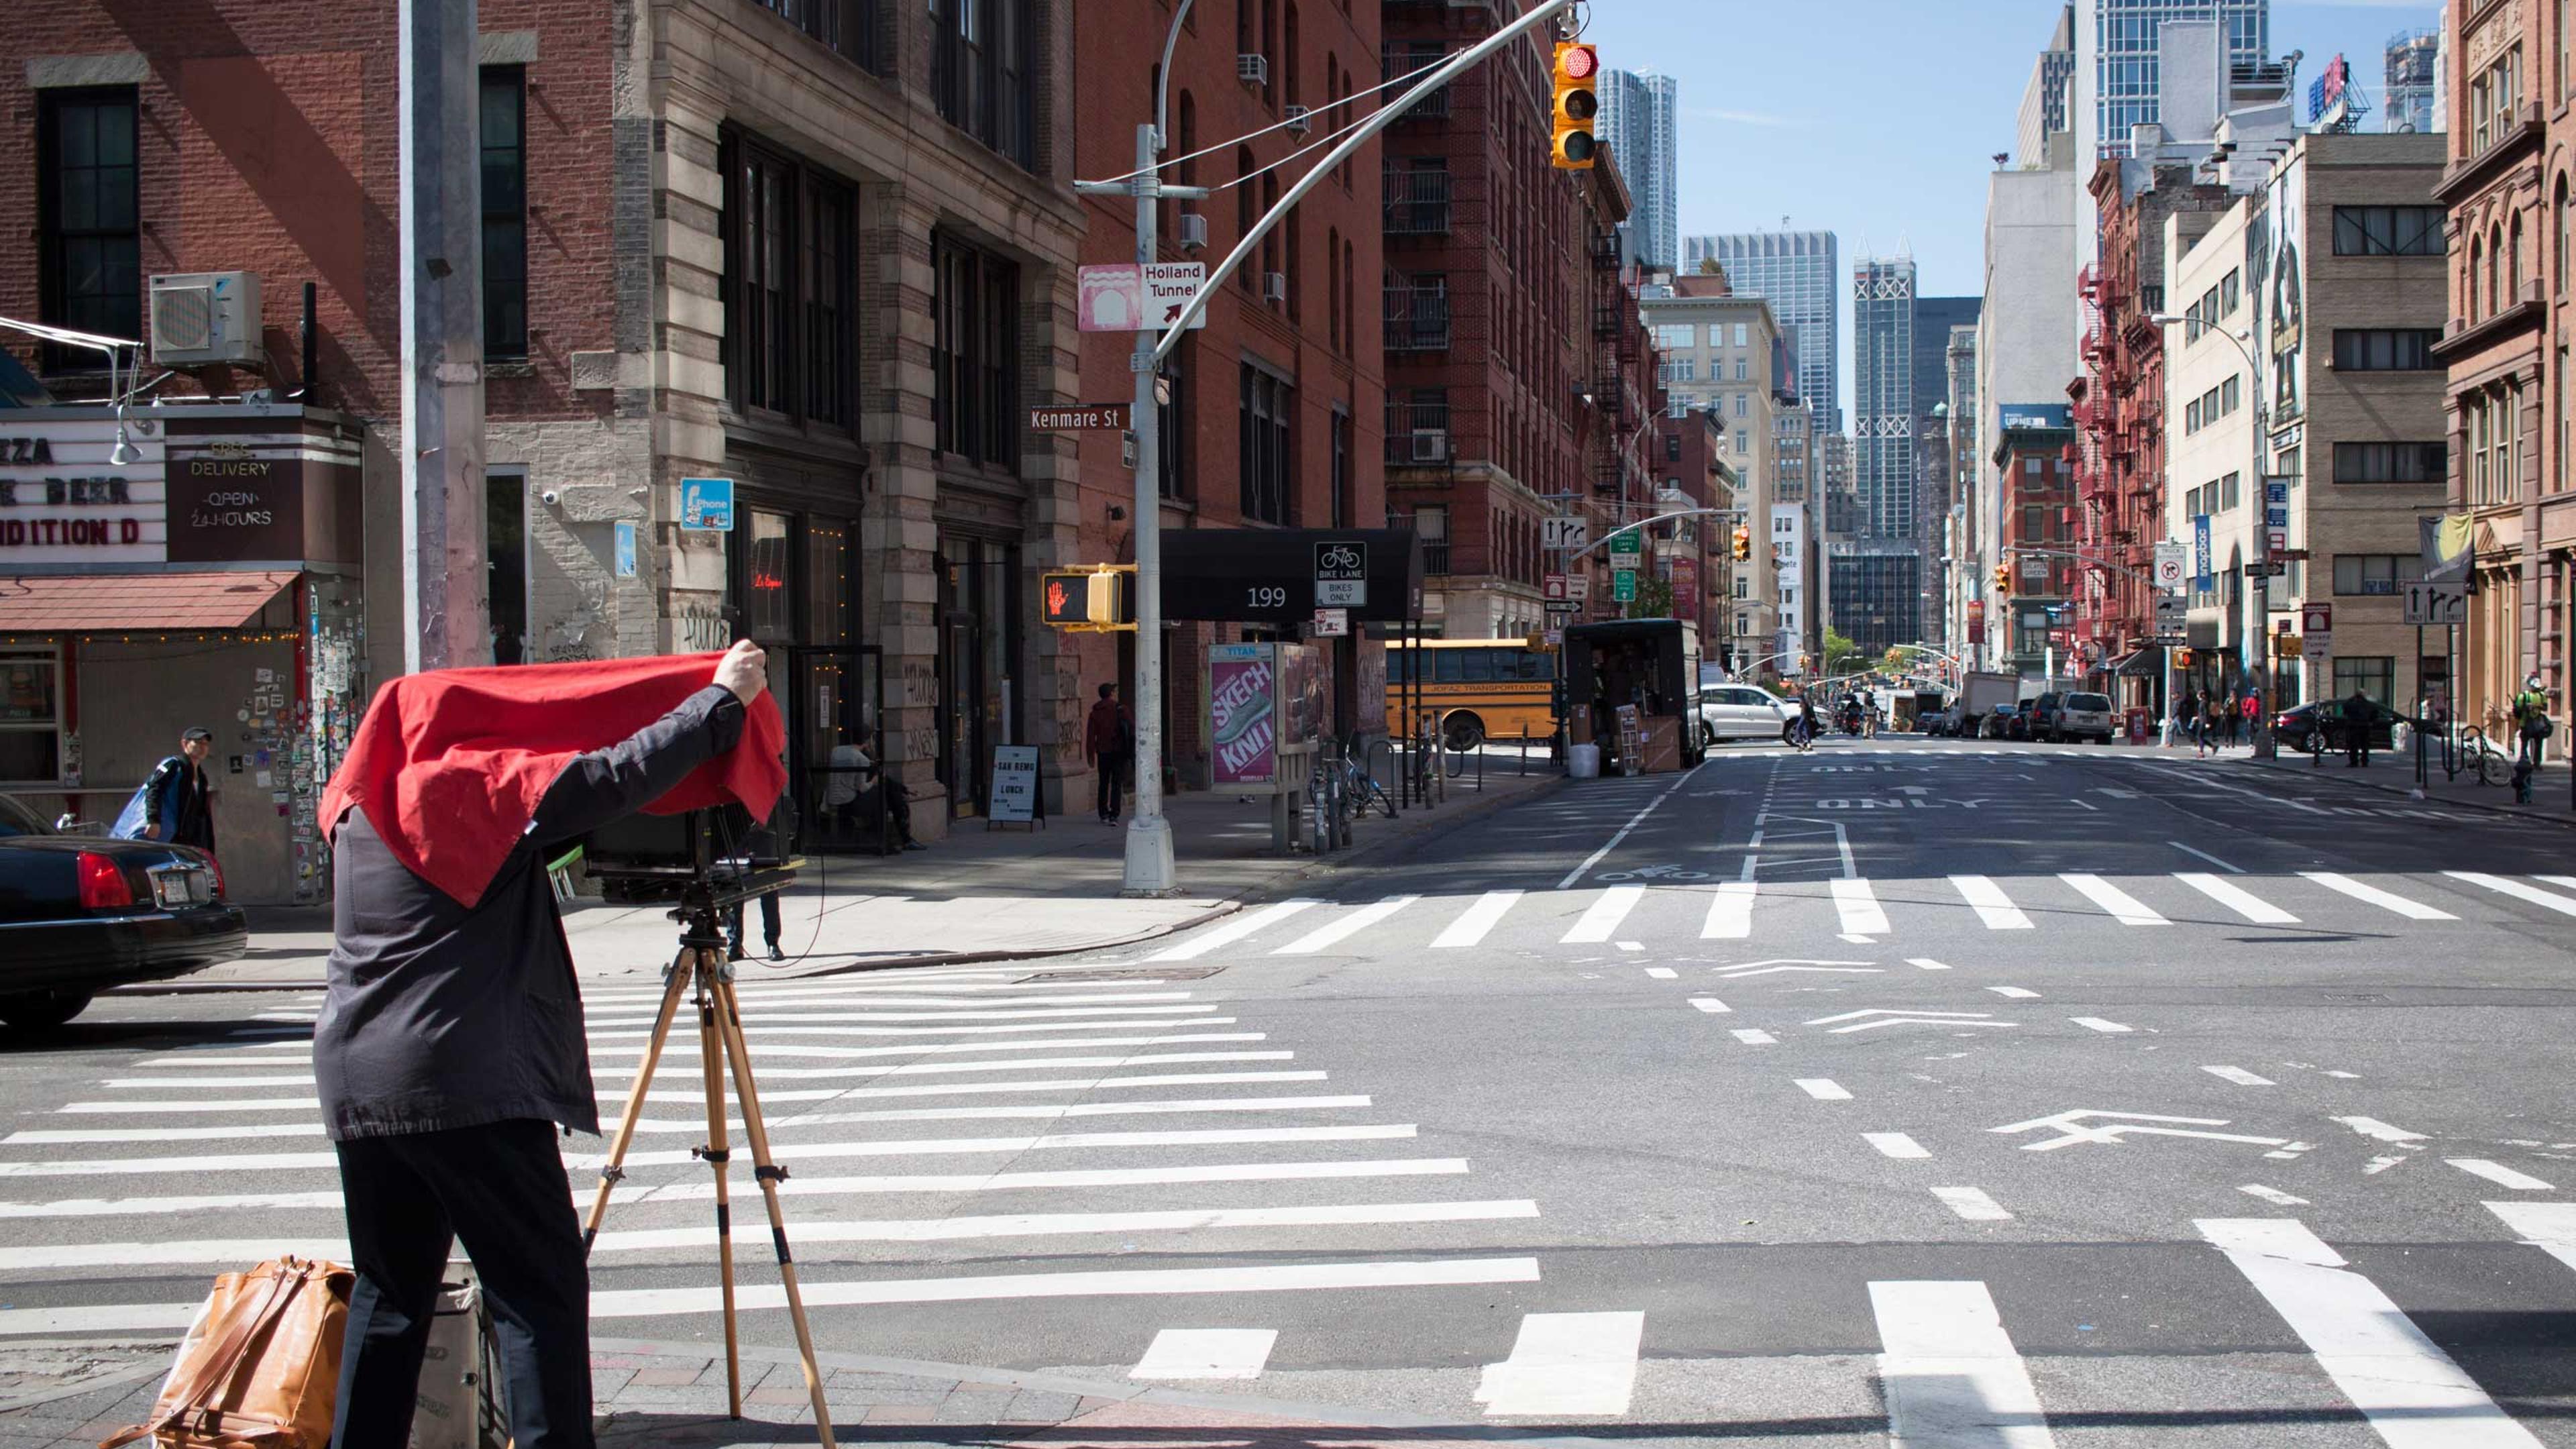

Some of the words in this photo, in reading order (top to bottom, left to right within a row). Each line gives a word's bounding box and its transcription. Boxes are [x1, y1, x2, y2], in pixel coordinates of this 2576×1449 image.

[1146, 266, 1200, 279] Holland
[1150, 284, 1197, 297] Tunnel
[1031, 411, 1097, 428] Kenmare
[1104, 410, 1119, 427] St
[191, 462, 271, 476] DELIVERY
[45, 477, 129, 504] BEER
[208, 492, 254, 506] OPEN
[697, 498, 727, 509] Phone
[0, 519, 109, 545] DITION
[1319, 570, 1337, 578] BIKE
[1340, 570, 1362, 578] LANE
[1328, 584, 1353, 592] BIKES
[1247, 587, 1286, 607] 199
[1330, 594, 1352, 602] ONLY
[1316, 612, 1326, 622] NO
[1227, 647, 1256, 656] TITAN
[1465, 684, 1548, 692] TRANSPORTATION
[1817, 798, 1990, 808] ONLY
